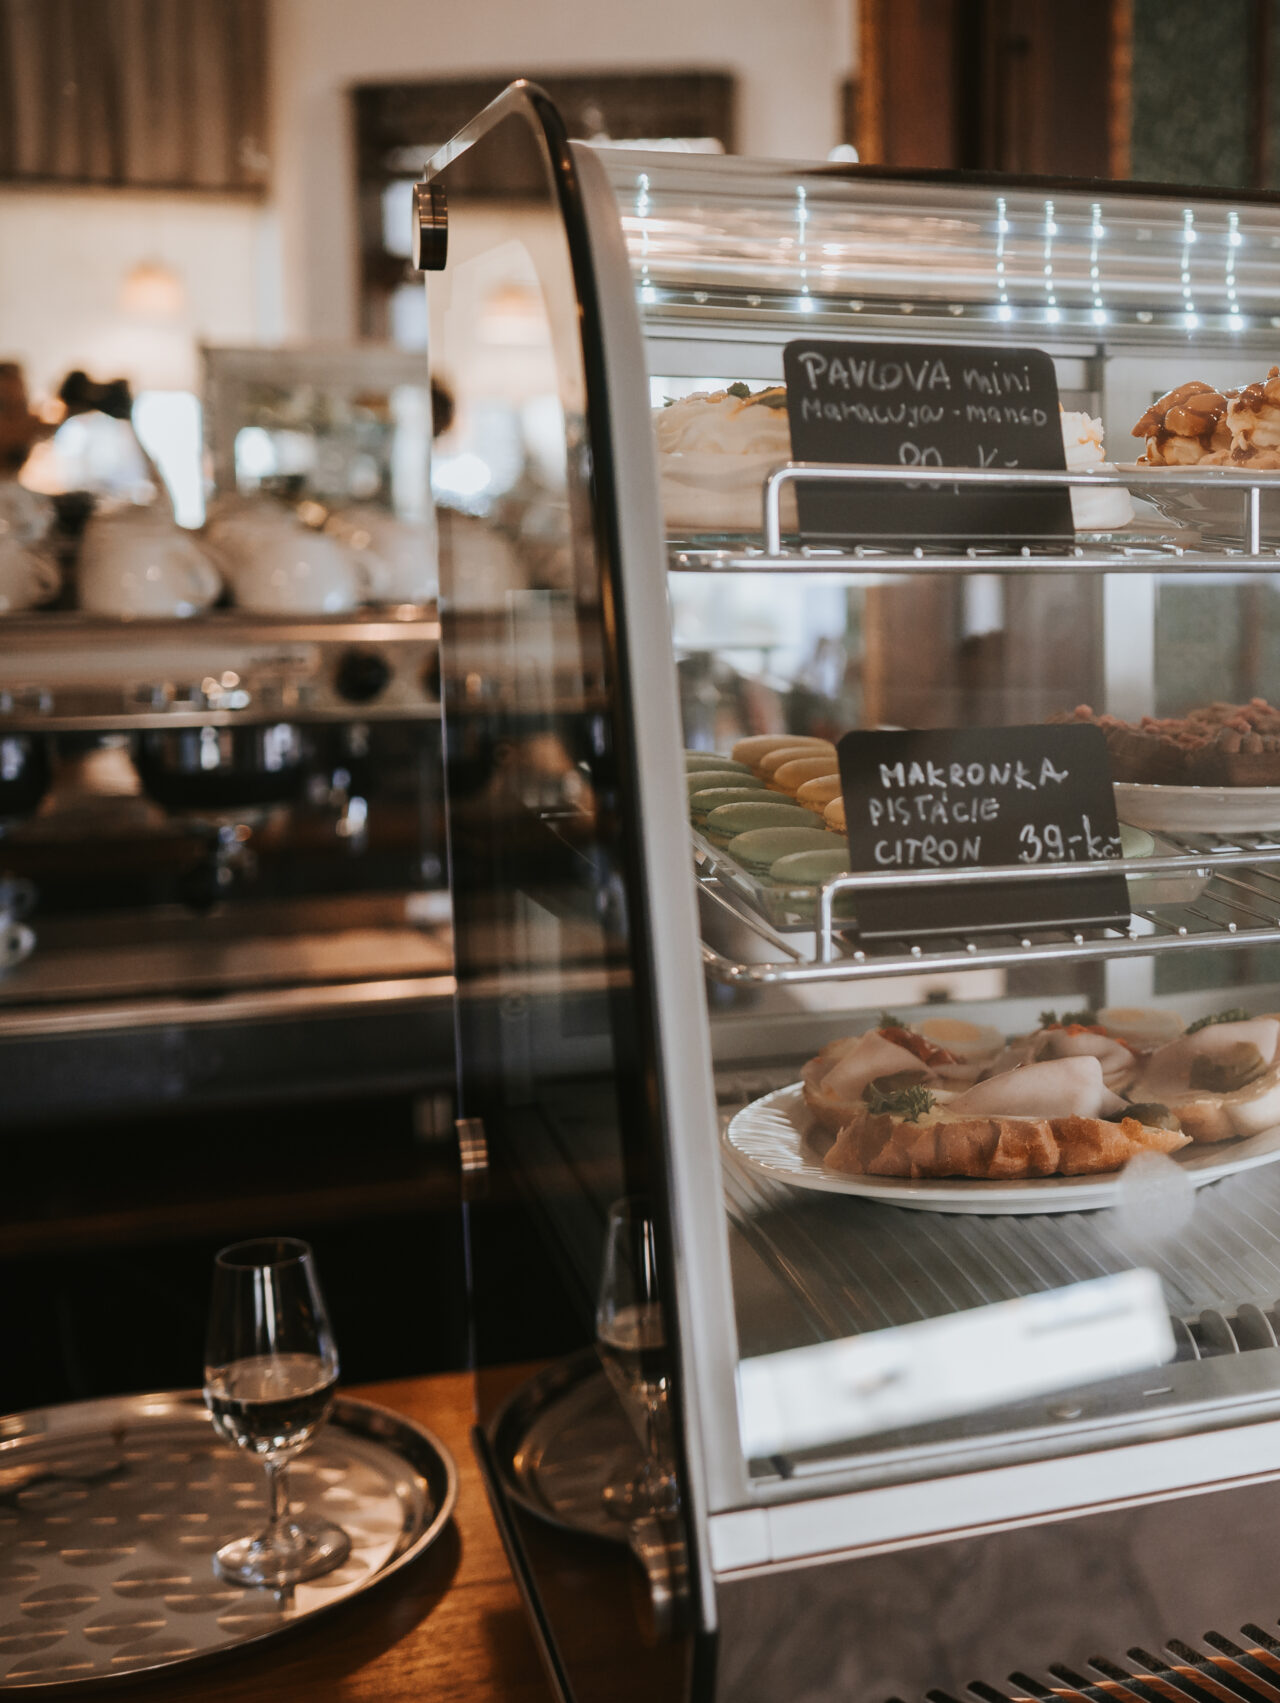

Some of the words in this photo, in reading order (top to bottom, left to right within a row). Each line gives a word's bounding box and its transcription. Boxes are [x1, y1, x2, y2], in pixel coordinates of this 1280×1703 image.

[799, 352, 951, 391] PAVLOVA
[963, 360, 1031, 395] mini
[879, 757, 1069, 791] MAKRONKA
[869, 791, 1001, 826] PISTÁCIE
[874, 834, 981, 866] CITRON
